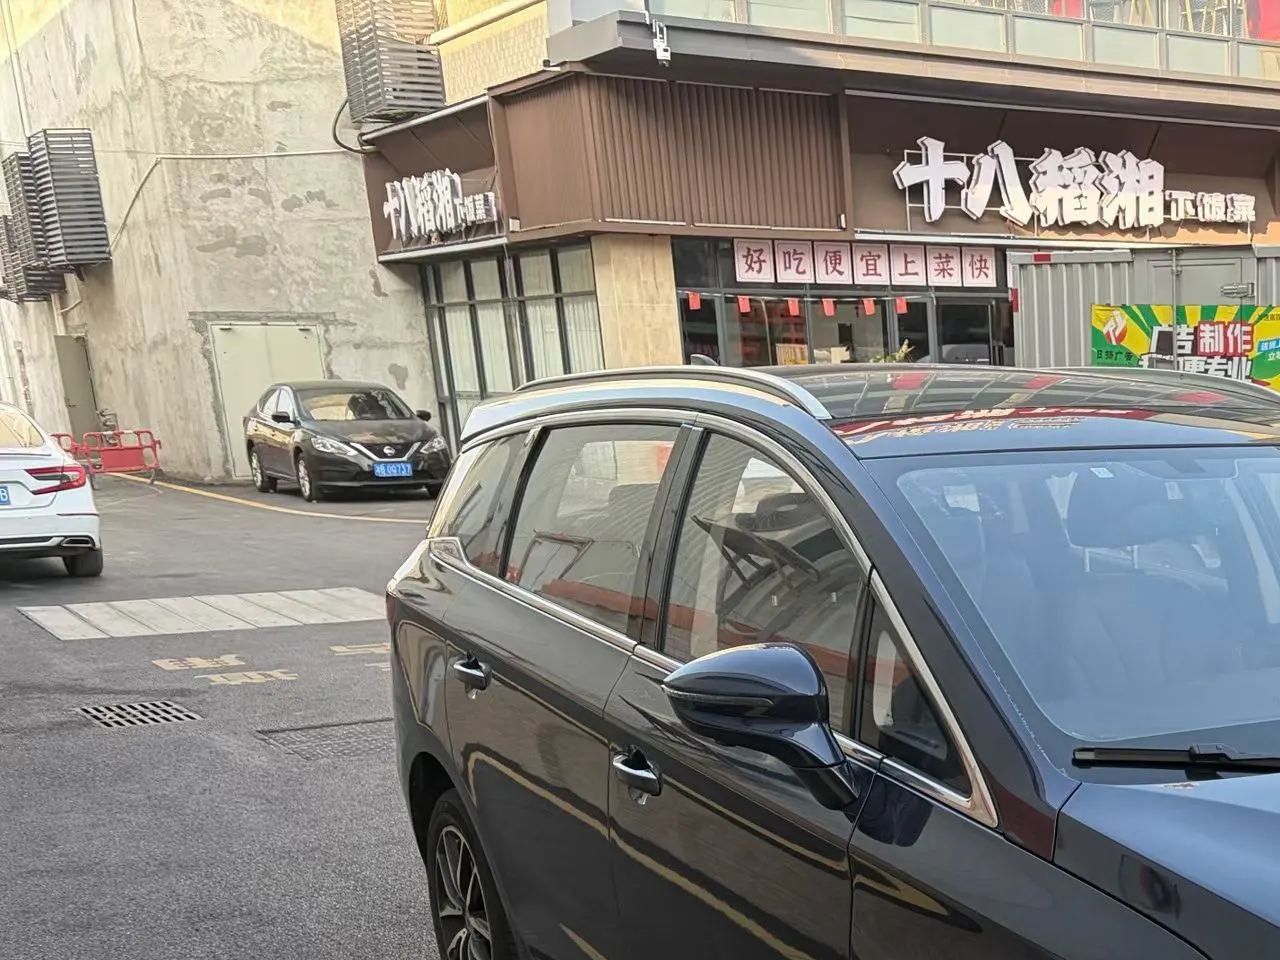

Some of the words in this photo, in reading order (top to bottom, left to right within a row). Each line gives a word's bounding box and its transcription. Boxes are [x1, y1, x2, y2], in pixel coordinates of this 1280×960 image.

[1165, 189, 1257, 223] 下饭菜
[742, 246, 990, 280] 好吃便宜上菜快
